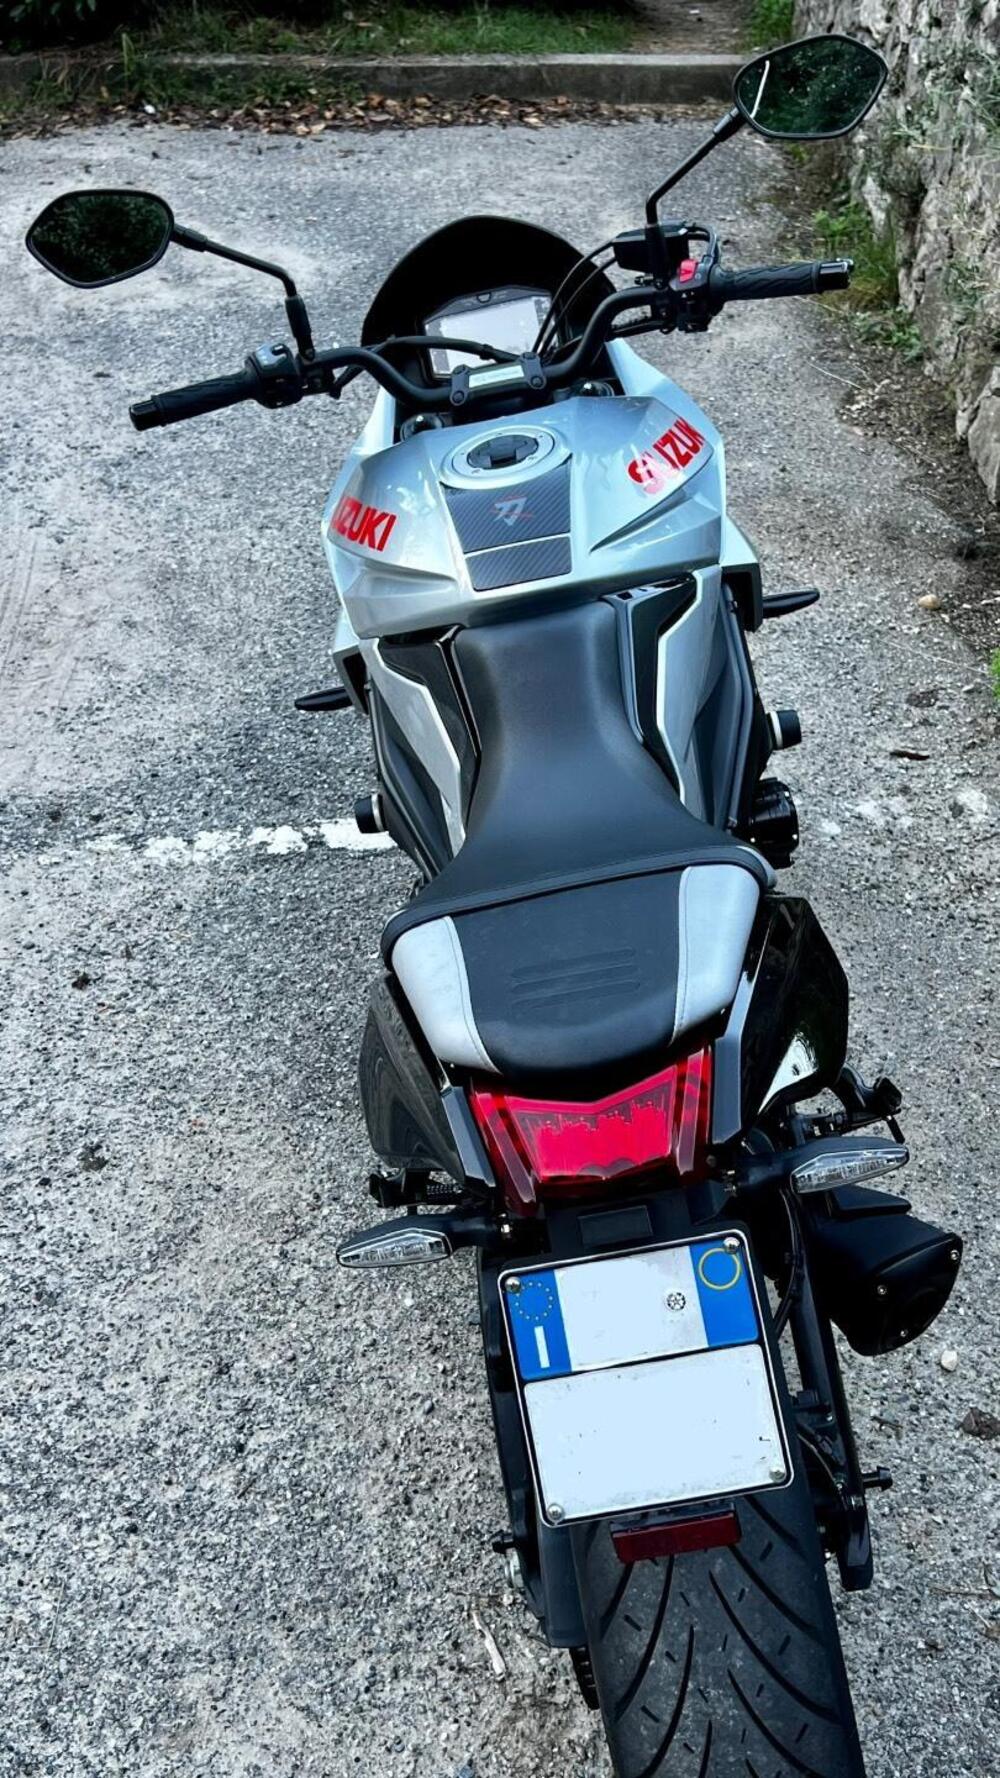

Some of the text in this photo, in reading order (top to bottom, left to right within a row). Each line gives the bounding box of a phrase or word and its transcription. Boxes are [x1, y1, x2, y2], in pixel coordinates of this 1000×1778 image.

[627, 416, 705, 494] SUZUK
[332, 496, 397, 552] ZUKI
[534, 1325, 550, 1369] I
